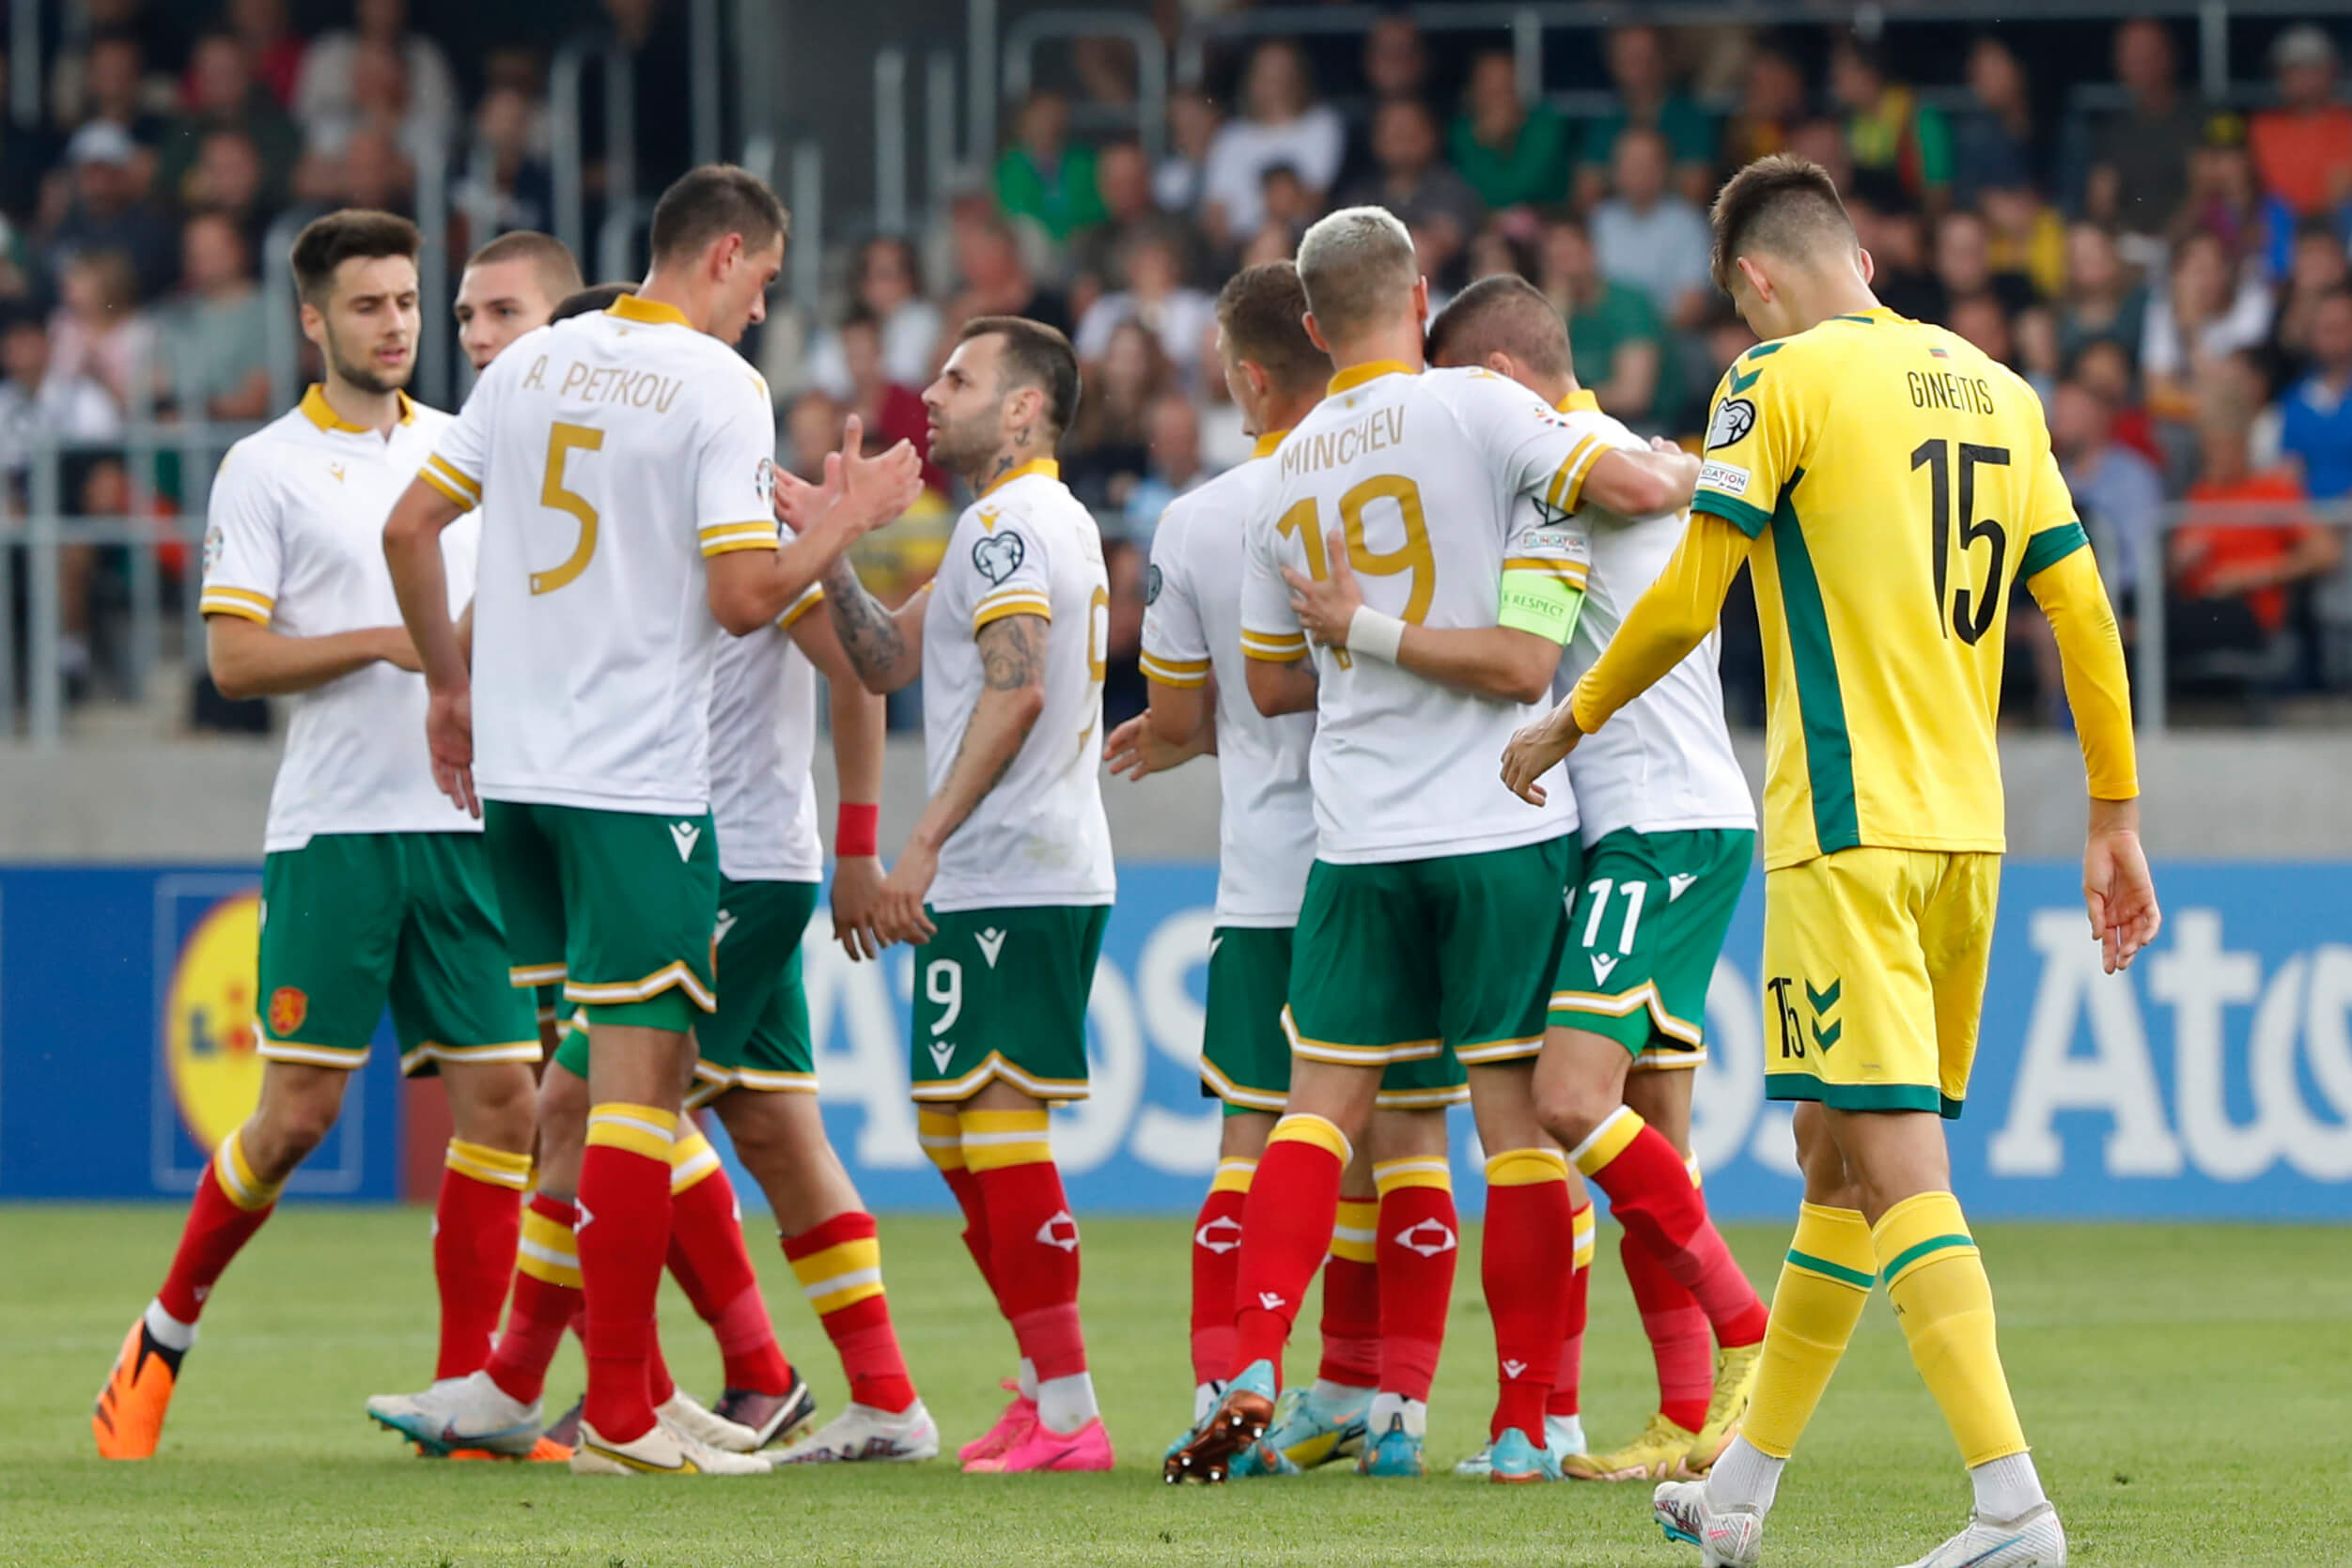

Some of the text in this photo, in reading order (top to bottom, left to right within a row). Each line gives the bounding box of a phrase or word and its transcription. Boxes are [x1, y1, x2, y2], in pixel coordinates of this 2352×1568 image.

[560, 361, 683, 414] PETKOV
[1280, 405, 1405, 482] MINCHEV
[529, 420, 605, 597] 5
[1909, 438, 2011, 646] 15
[1275, 473, 1436, 672] 19
[1582, 877, 1647, 955] 11
[926, 958, 962, 1036] 9
[1767, 977, 1805, 1059] 15
[1986, 907, 2352, 1182] Ato
